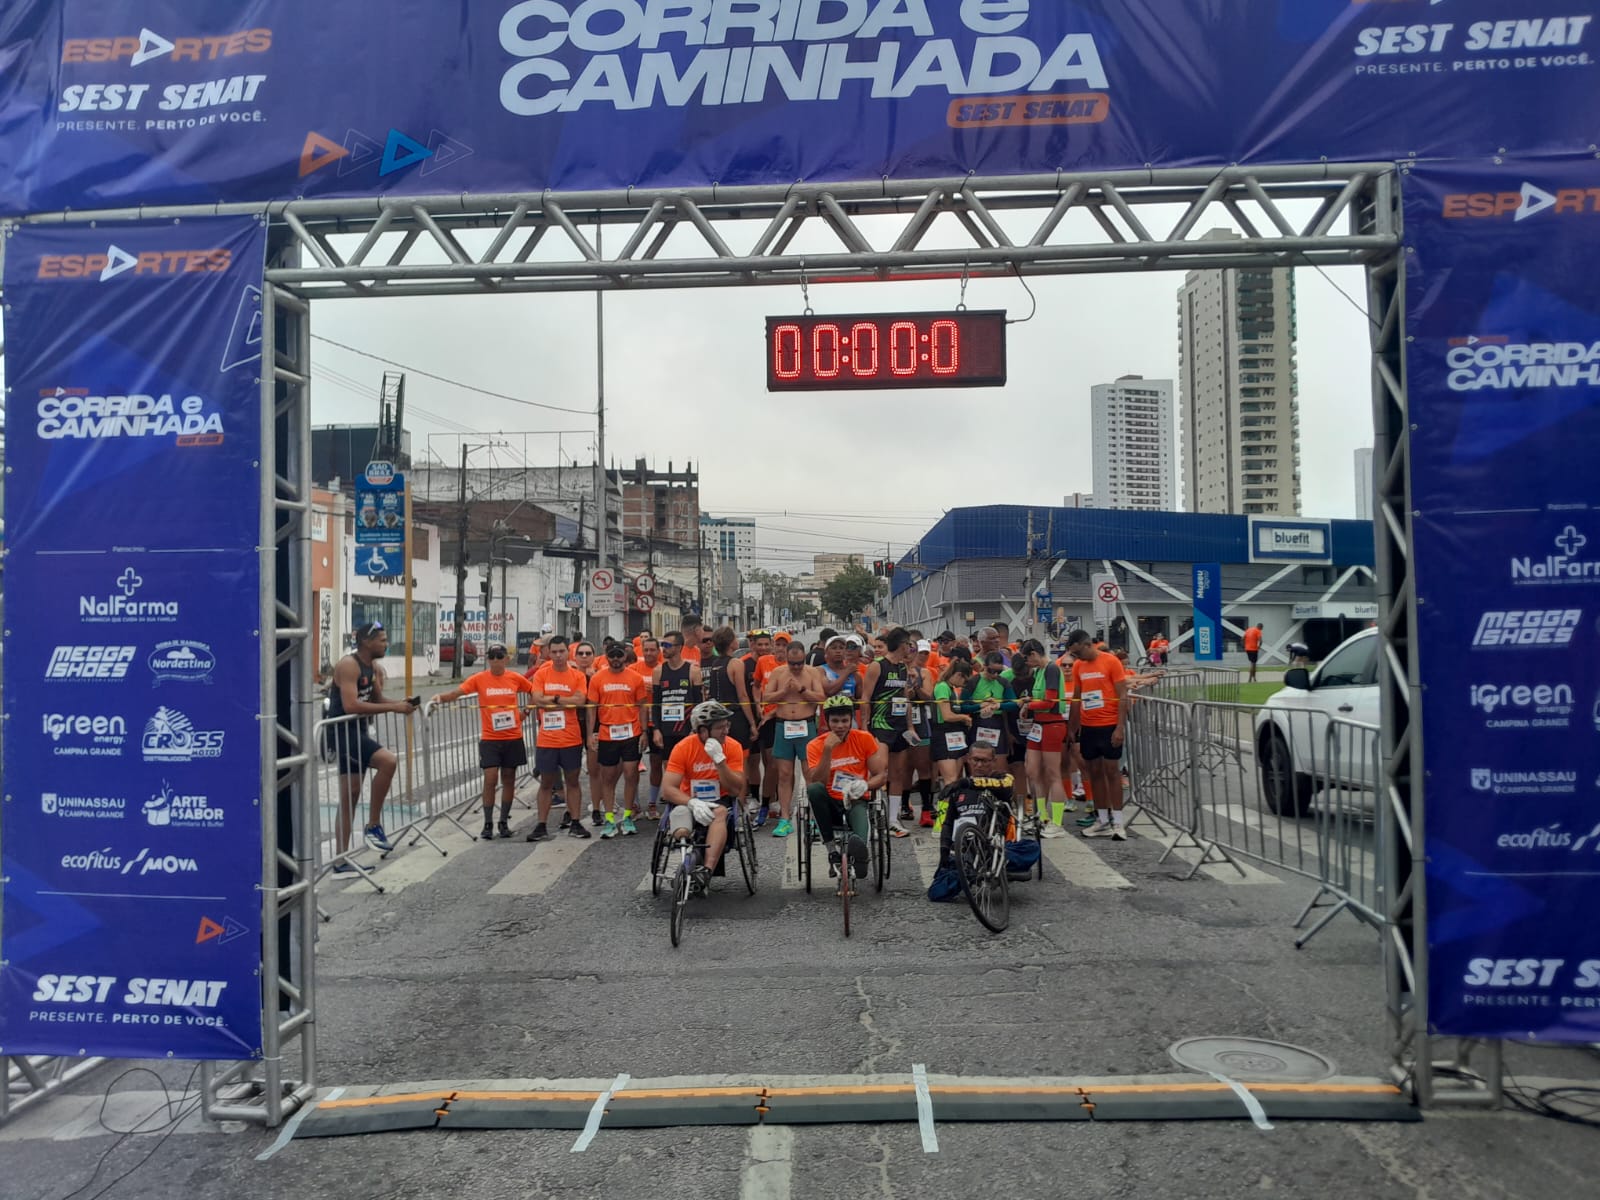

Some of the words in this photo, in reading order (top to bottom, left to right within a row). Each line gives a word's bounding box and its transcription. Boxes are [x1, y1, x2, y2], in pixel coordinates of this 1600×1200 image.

[499, 0, 934, 57] CORRIDA
[960, 0, 1030, 34] e
[1354, 23, 1453, 56] SEST
[1464, 15, 1592, 51] SENAT
[1355, 63, 1447, 76] PRESENTE.
[1453, 59, 1510, 72] PERTO
[1514, 57, 1537, 69] DE
[1541, 52, 1595, 67] VOCÊ.
[500, 33, 1109, 116] CAMINHADA
[59, 84, 149, 112] SEST
[159, 75, 267, 110] SENAT
[957, 102, 1015, 122] SEST
[1023, 99, 1103, 119] SENAT
[57, 119, 140, 132] PRESENTE.
[146, 119, 195, 131] PERTO
[200, 114, 216, 126] DE
[220, 110, 267, 124] VOCÊ.
[37, 394, 174, 419] CORRIDA
[37, 413, 224, 439] CAMINHADA
[1275, 532, 1310, 544] bluefit
[1511, 556, 1600, 578] NalFar
[80, 595, 178, 615] NalFarma
[1477, 609, 1582, 628] MEGGA
[1472, 627, 1574, 646] SHOES
[52, 646, 137, 661] MEGGA
[46, 662, 129, 678] SHOES
[152, 658, 211, 669] Nordestina
[1486, 720, 1529, 728] CAMPINA
[1532, 718, 1569, 727] GRANDE
[53, 746, 88, 756] CAMPINA
[90, 746, 122, 756] GRANDE
[1493, 772, 1576, 783] UNINASSAU
[1502, 785, 1540, 793] CAMPINA
[1542, 784, 1576, 792] GRANDE
[58, 797, 126, 809] UNINASSAU
[171, 796, 207, 808] ARTE
[64, 809, 95, 818] CAMPINA
[97, 810, 125, 819] GRANDE
[1464, 958, 1565, 988] SEST
[33, 974, 117, 1003] SEST
[124, 978, 227, 1007] SENAT
[29, 1011, 108, 1023] PRESENTE.
[112, 1013, 160, 1024] PERTO
[164, 1015, 182, 1025] DE
[186, 1015, 228, 1027] VOCÊ.
